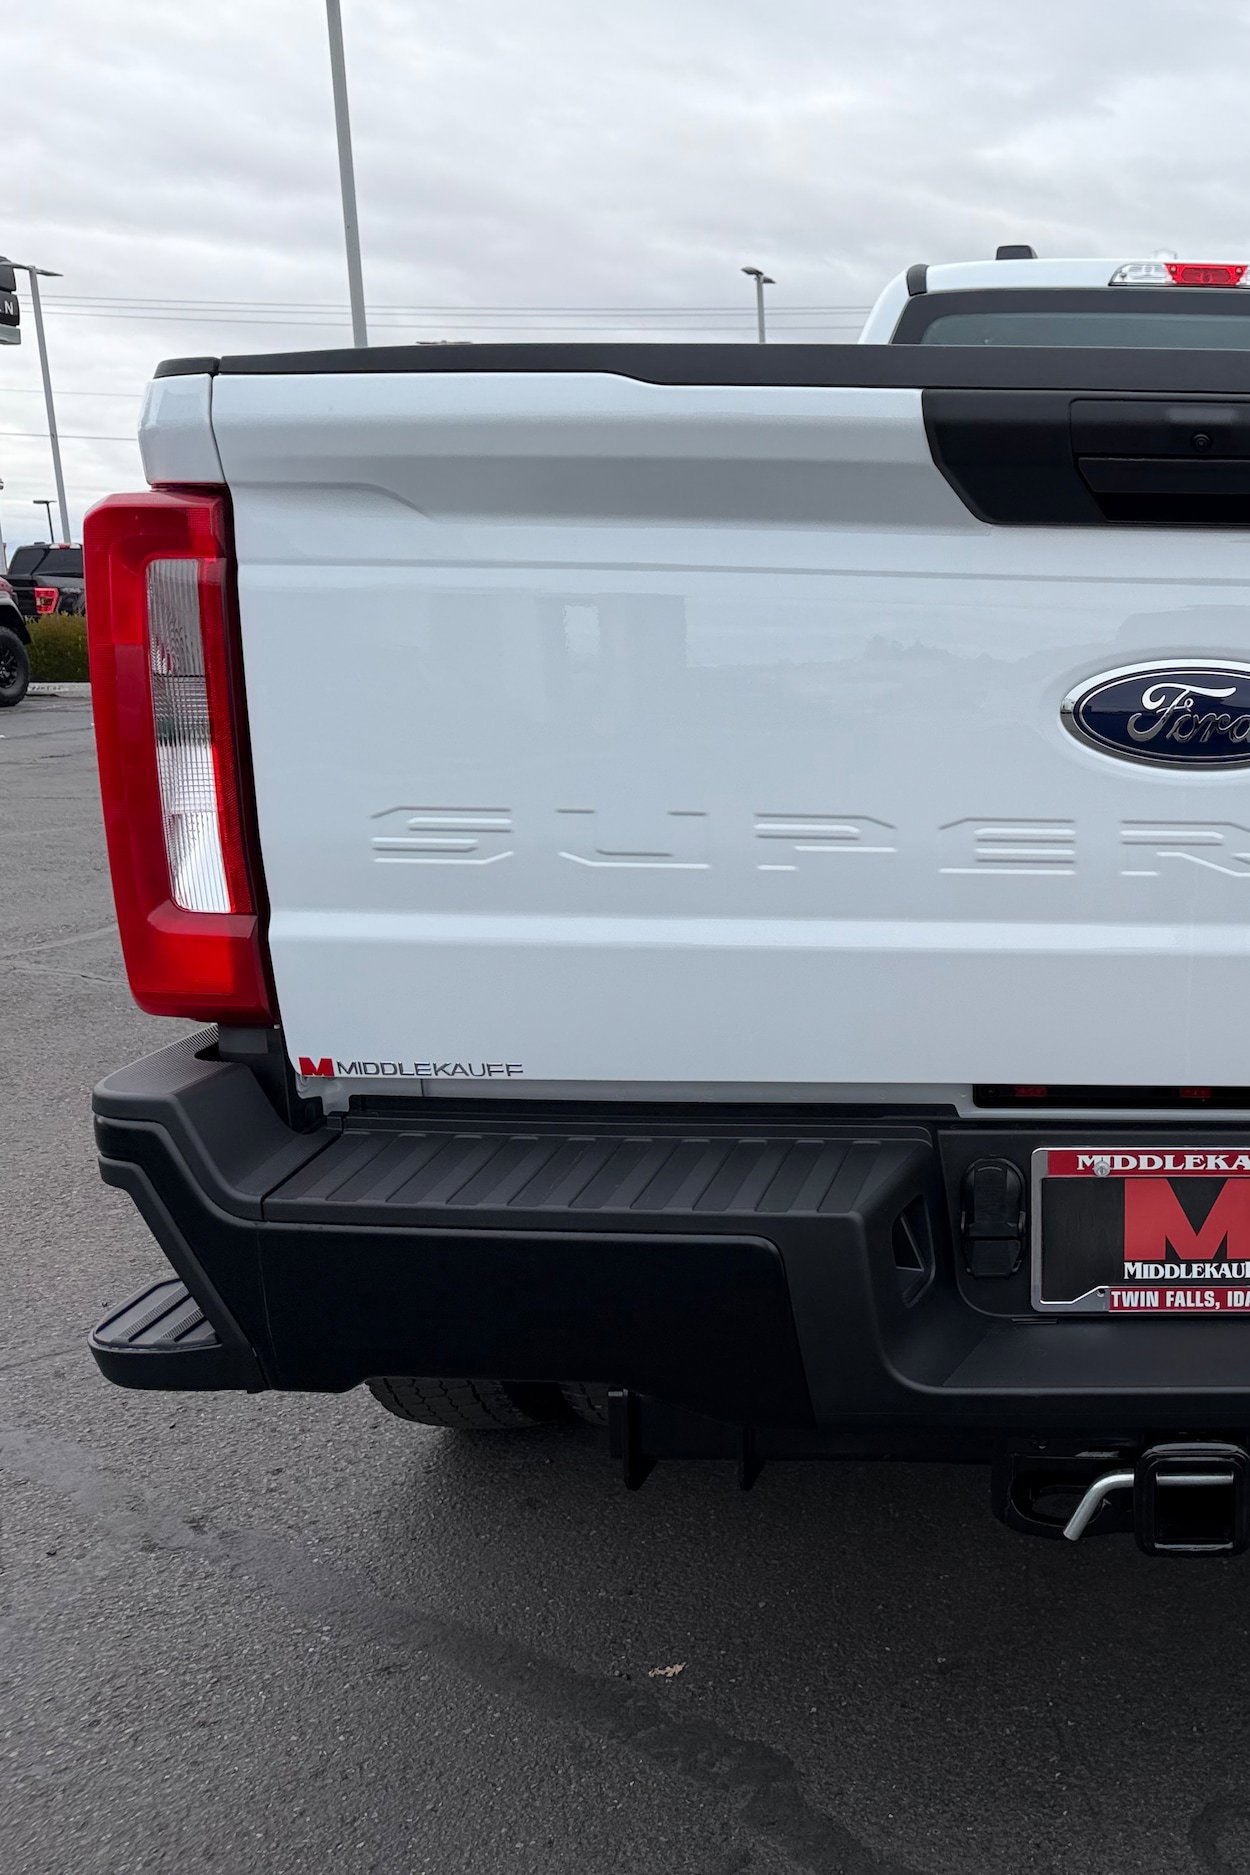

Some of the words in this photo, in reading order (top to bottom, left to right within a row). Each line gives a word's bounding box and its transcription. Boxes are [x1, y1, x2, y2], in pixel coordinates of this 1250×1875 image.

[298, 1057, 335, 1077] M
[336, 1061, 524, 1077] MIDDLEKAUFF
[1111, 1291, 1159, 1308] TWIN
[1165, 1291, 1221, 1310] FALLS,
